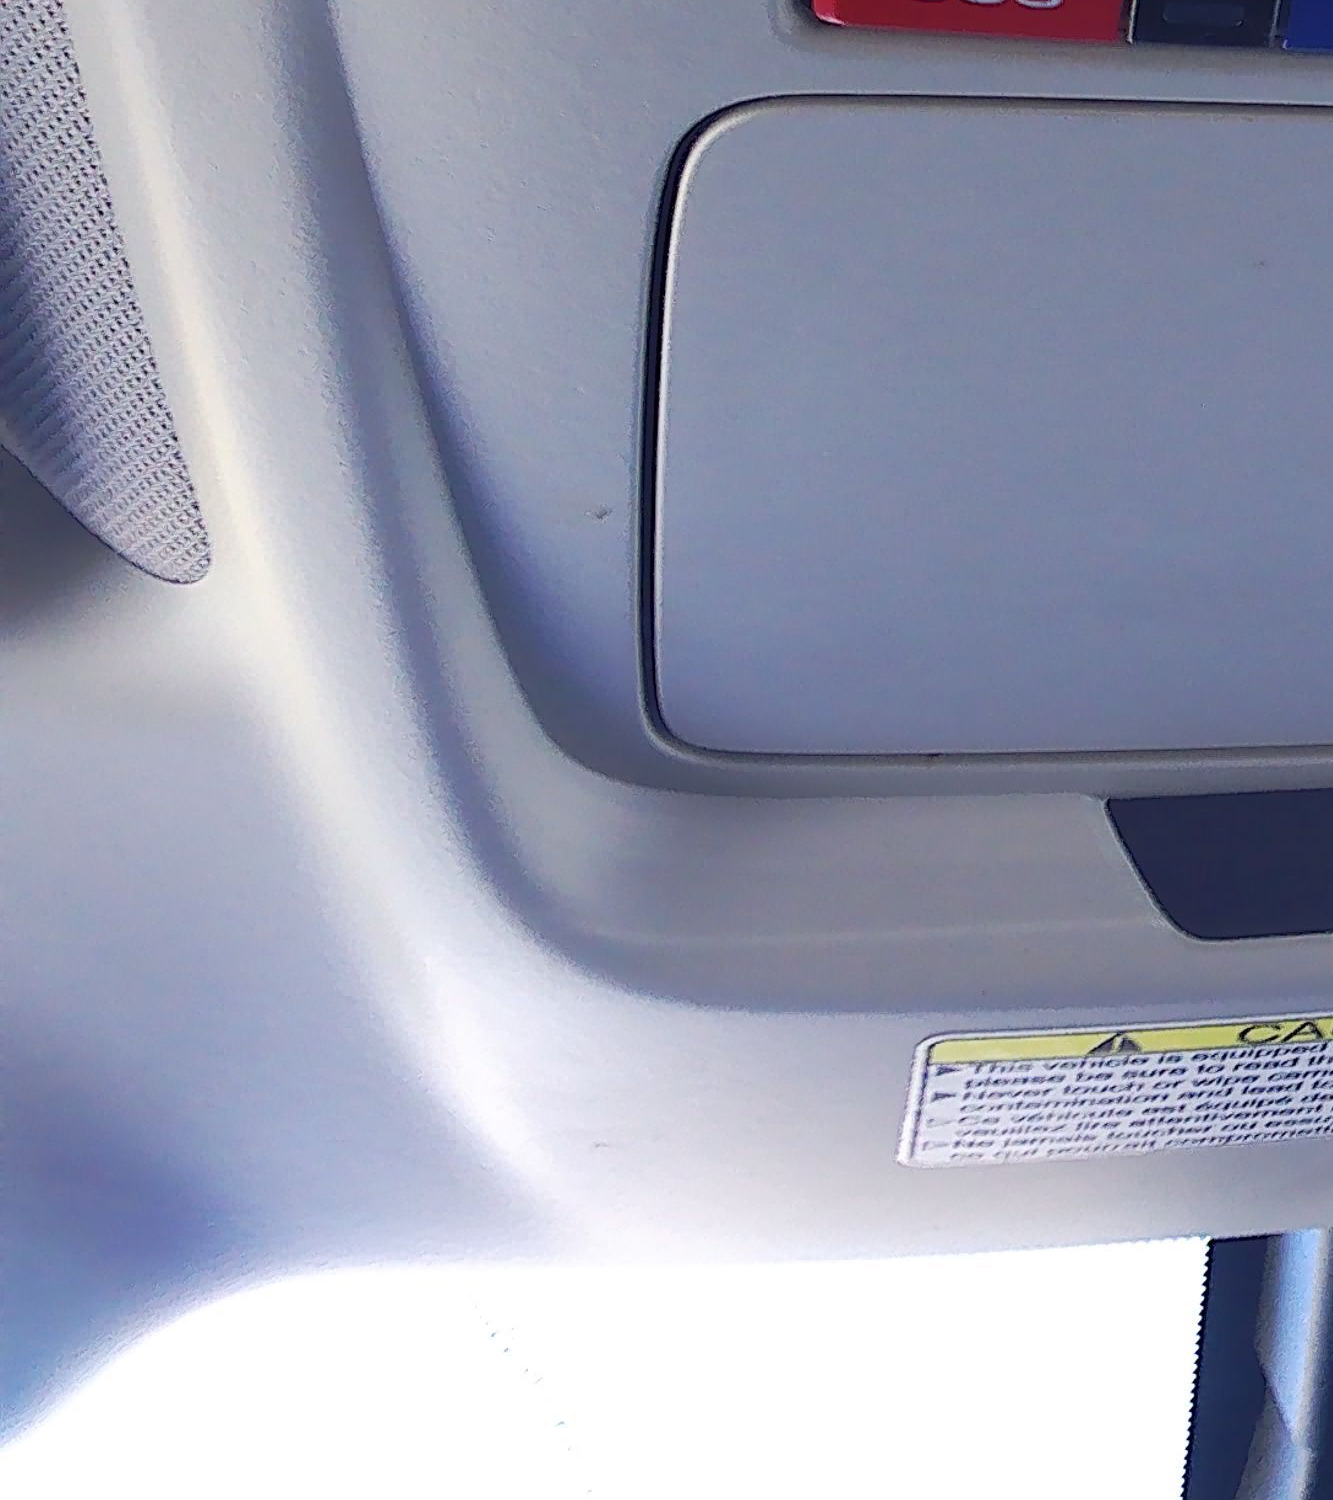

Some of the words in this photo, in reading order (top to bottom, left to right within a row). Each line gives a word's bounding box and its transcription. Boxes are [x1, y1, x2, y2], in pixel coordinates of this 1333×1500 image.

[965, 1076, 1067, 1089] please
[1076, 1072, 1112, 1082] be
[1122, 1067, 1187, 1078] sure
[1197, 1063, 1226, 1074] to
[1232, 1057, 1299, 1071] read
[968, 1063, 1032, 1074] This
[1043, 1056, 1148, 1070] vehicle
[1159, 1055, 1182, 1064] is
[1190, 1043, 1327, 1060] equipped
[960, 1093, 1169, 1112] contamination
[1178, 1086, 1234, 1100] and
[1241, 1081, 1303, 1095] lead
[962, 1088, 1052, 1100] Never
[1063, 1081, 1144, 1095] touch
[1152, 1079, 1184, 1090] or
[1192, 1074, 1260, 1088] wipe
